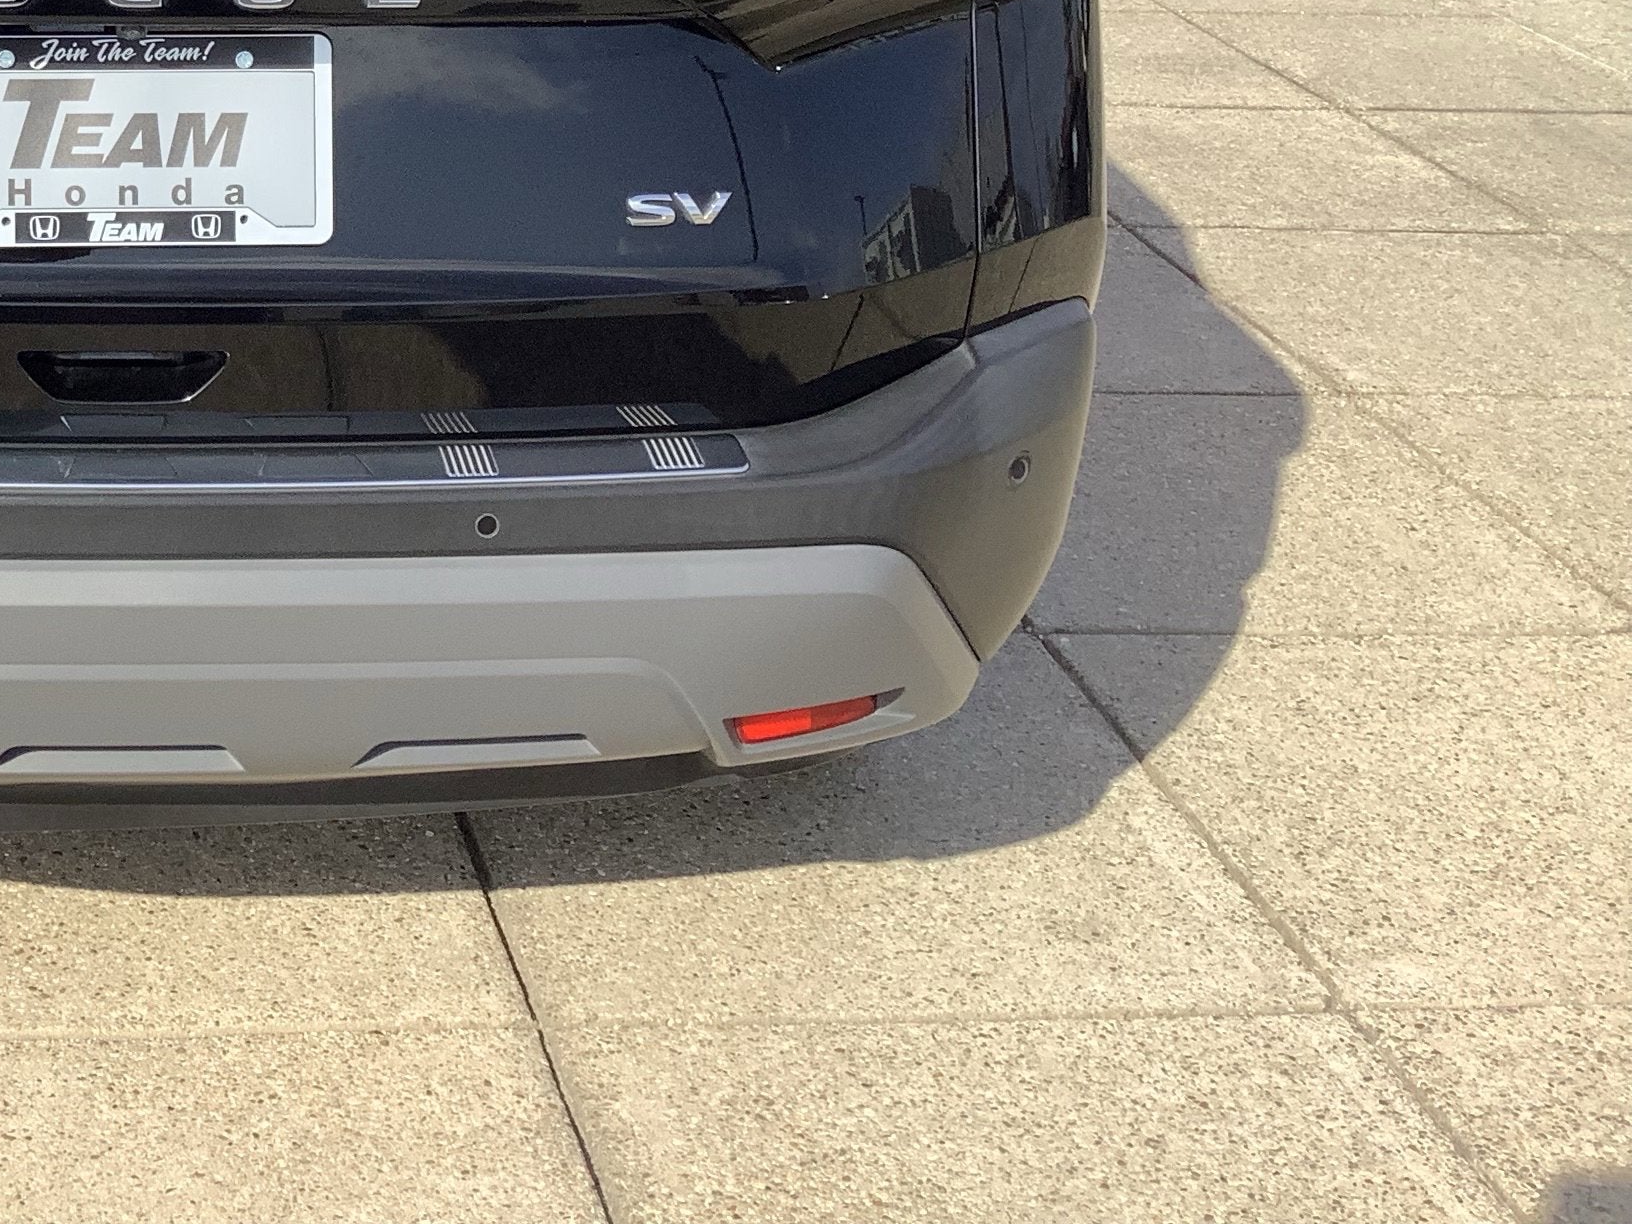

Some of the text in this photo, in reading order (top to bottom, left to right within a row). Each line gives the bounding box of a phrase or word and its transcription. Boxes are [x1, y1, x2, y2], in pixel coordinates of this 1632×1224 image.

[29, 38, 216, 70] Join The Team!
[2, 78, 249, 169] TEAM
[7, 177, 245, 207] Honda
[626, 191, 733, 226] SV
[86, 212, 165, 242] TEAM
